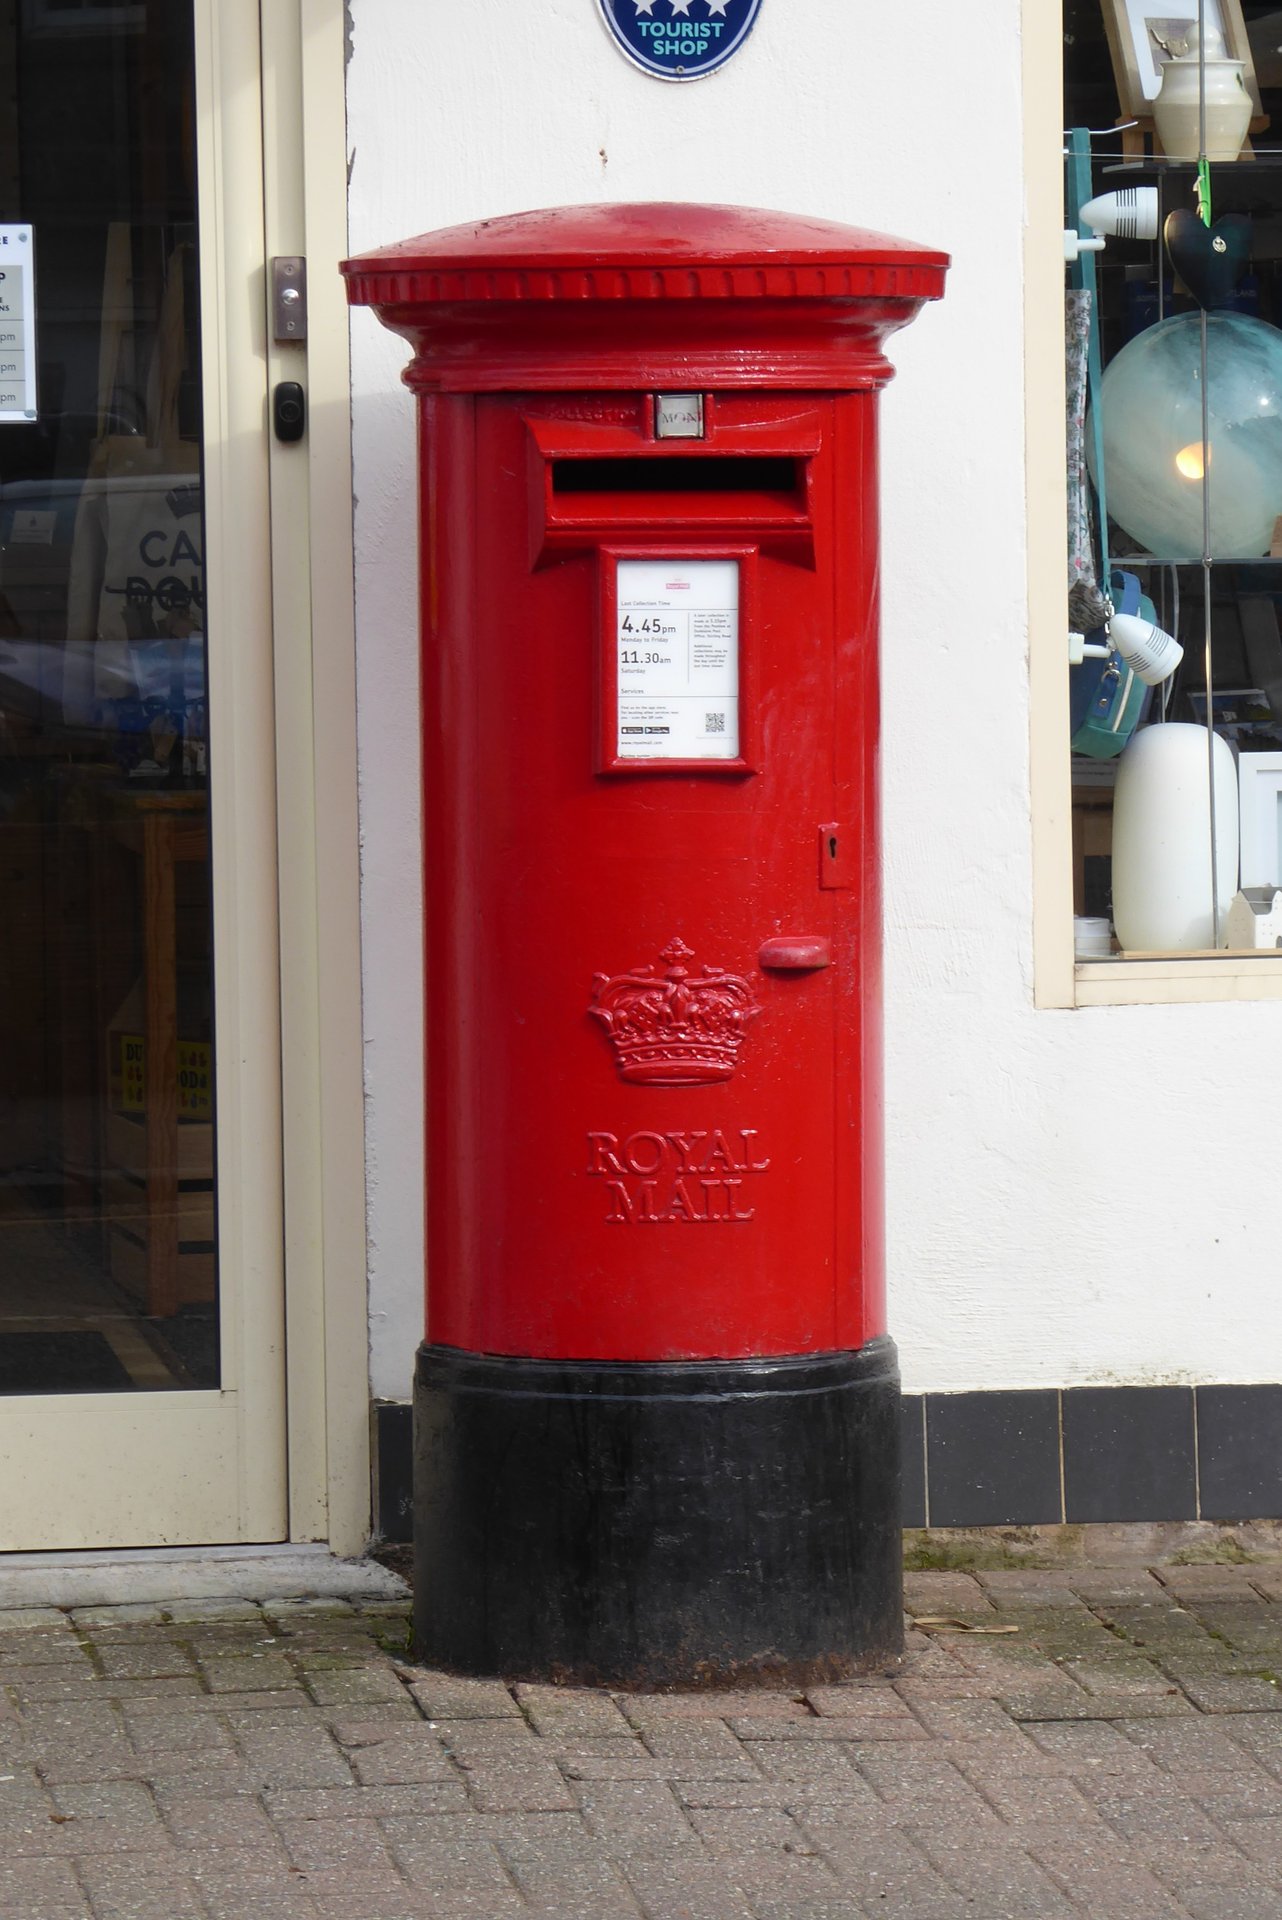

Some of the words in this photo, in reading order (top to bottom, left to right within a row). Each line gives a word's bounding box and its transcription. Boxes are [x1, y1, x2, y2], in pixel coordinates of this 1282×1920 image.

[637, 22, 724, 37] TOURIST
[653, 40, 708, 55] SHOP
[621, 614, 677, 634] 4.45pm
[621, 650, 672, 664] 11.30am
[586, 1129, 772, 1175] ROYAL
[604, 1179, 756, 1224] MAIL
